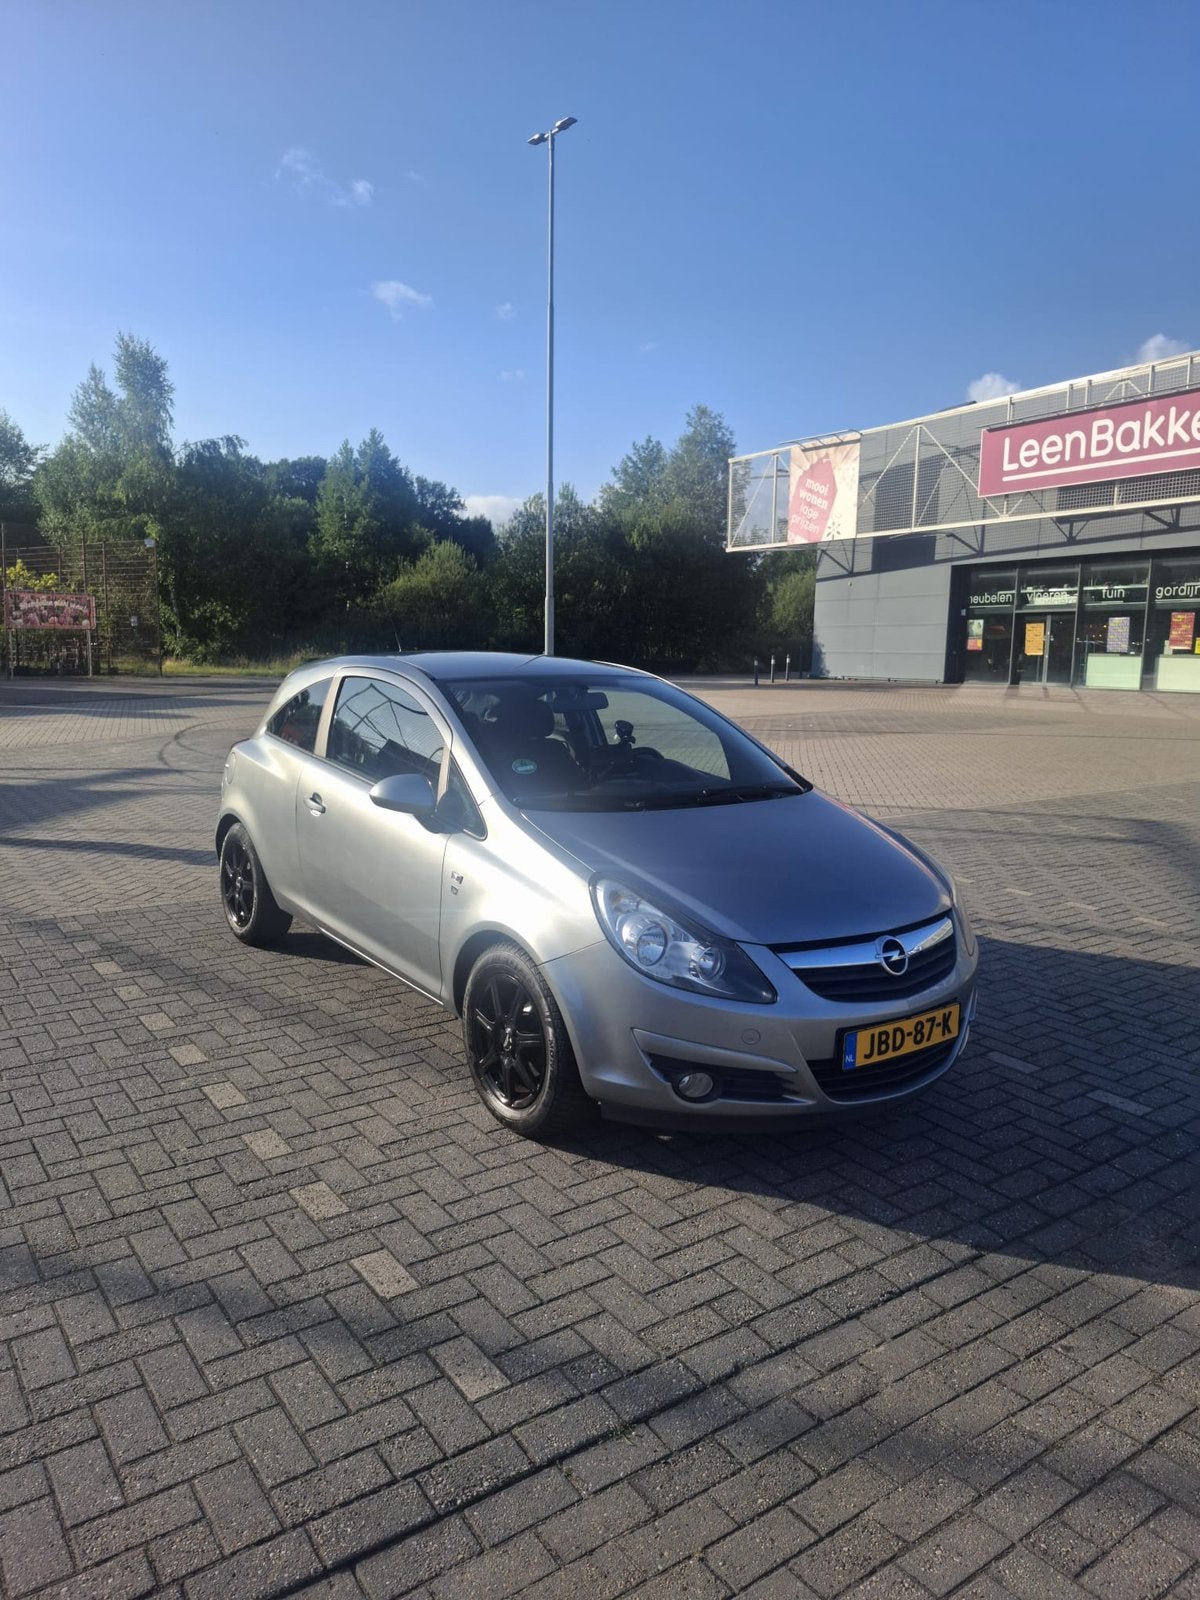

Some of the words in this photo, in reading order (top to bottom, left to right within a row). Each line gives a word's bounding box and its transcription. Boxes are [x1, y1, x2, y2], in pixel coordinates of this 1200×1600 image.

[805, 478, 829, 496] mooi
[799, 489, 828, 510] wonen
[800, 502, 819, 520] lage
[1101, 586, 1125, 599] tuin
[863, 1010, 953, 1060] JBD-87-K
[845, 1054, 855, 1063] NL
